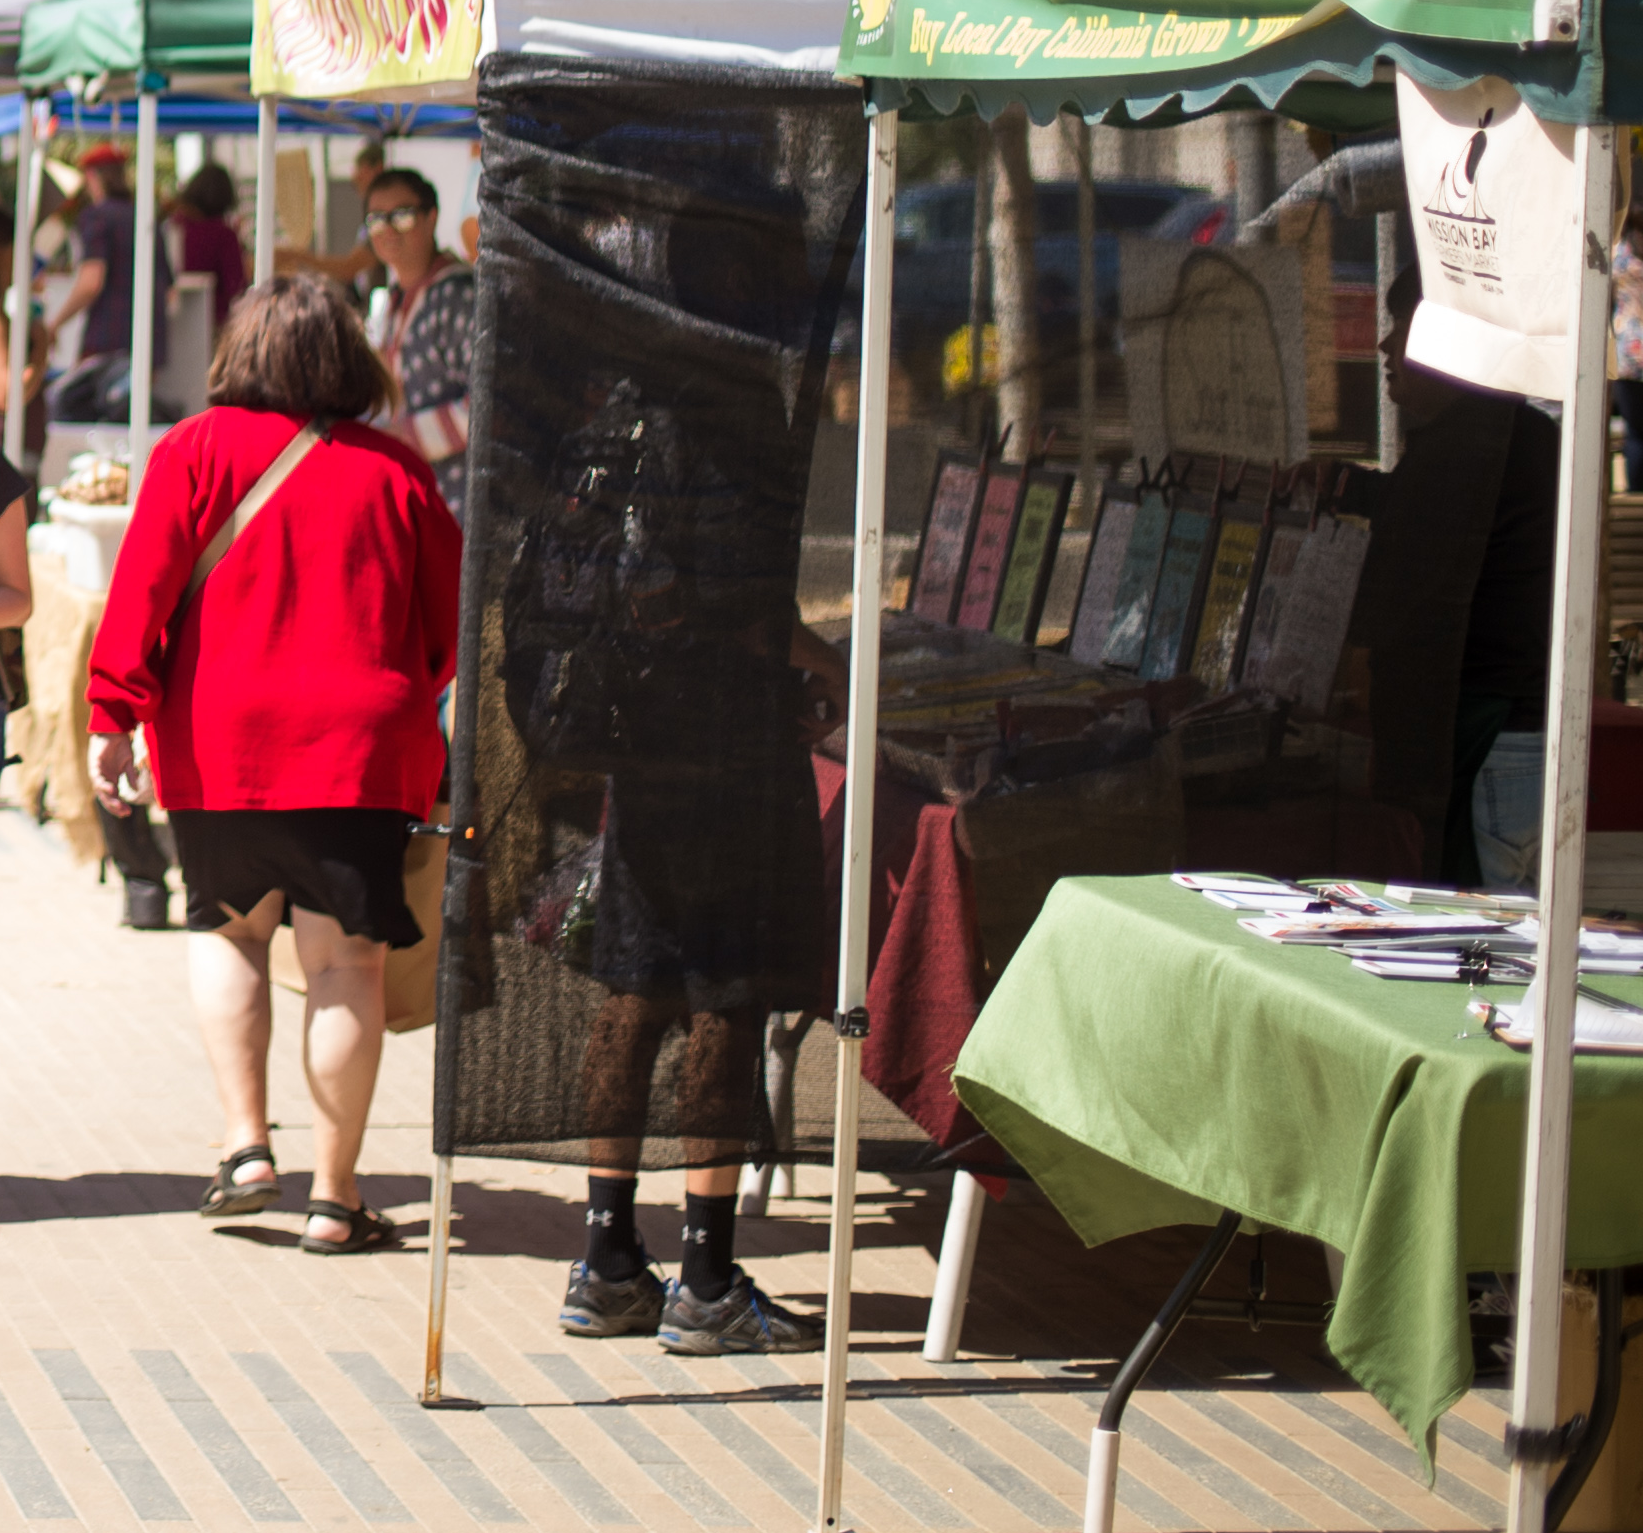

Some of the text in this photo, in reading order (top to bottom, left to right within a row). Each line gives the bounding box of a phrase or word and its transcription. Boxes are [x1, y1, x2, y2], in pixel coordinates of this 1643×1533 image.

[910, 8, 946, 66] Buy
[940, 11, 1013, 55] Local
[995, 16, 1053, 68] Buy
[1043, 13, 1153, 59] California
[1150, 9, 1231, 58] Grown
[1472, 226, 1497, 252] BAY
